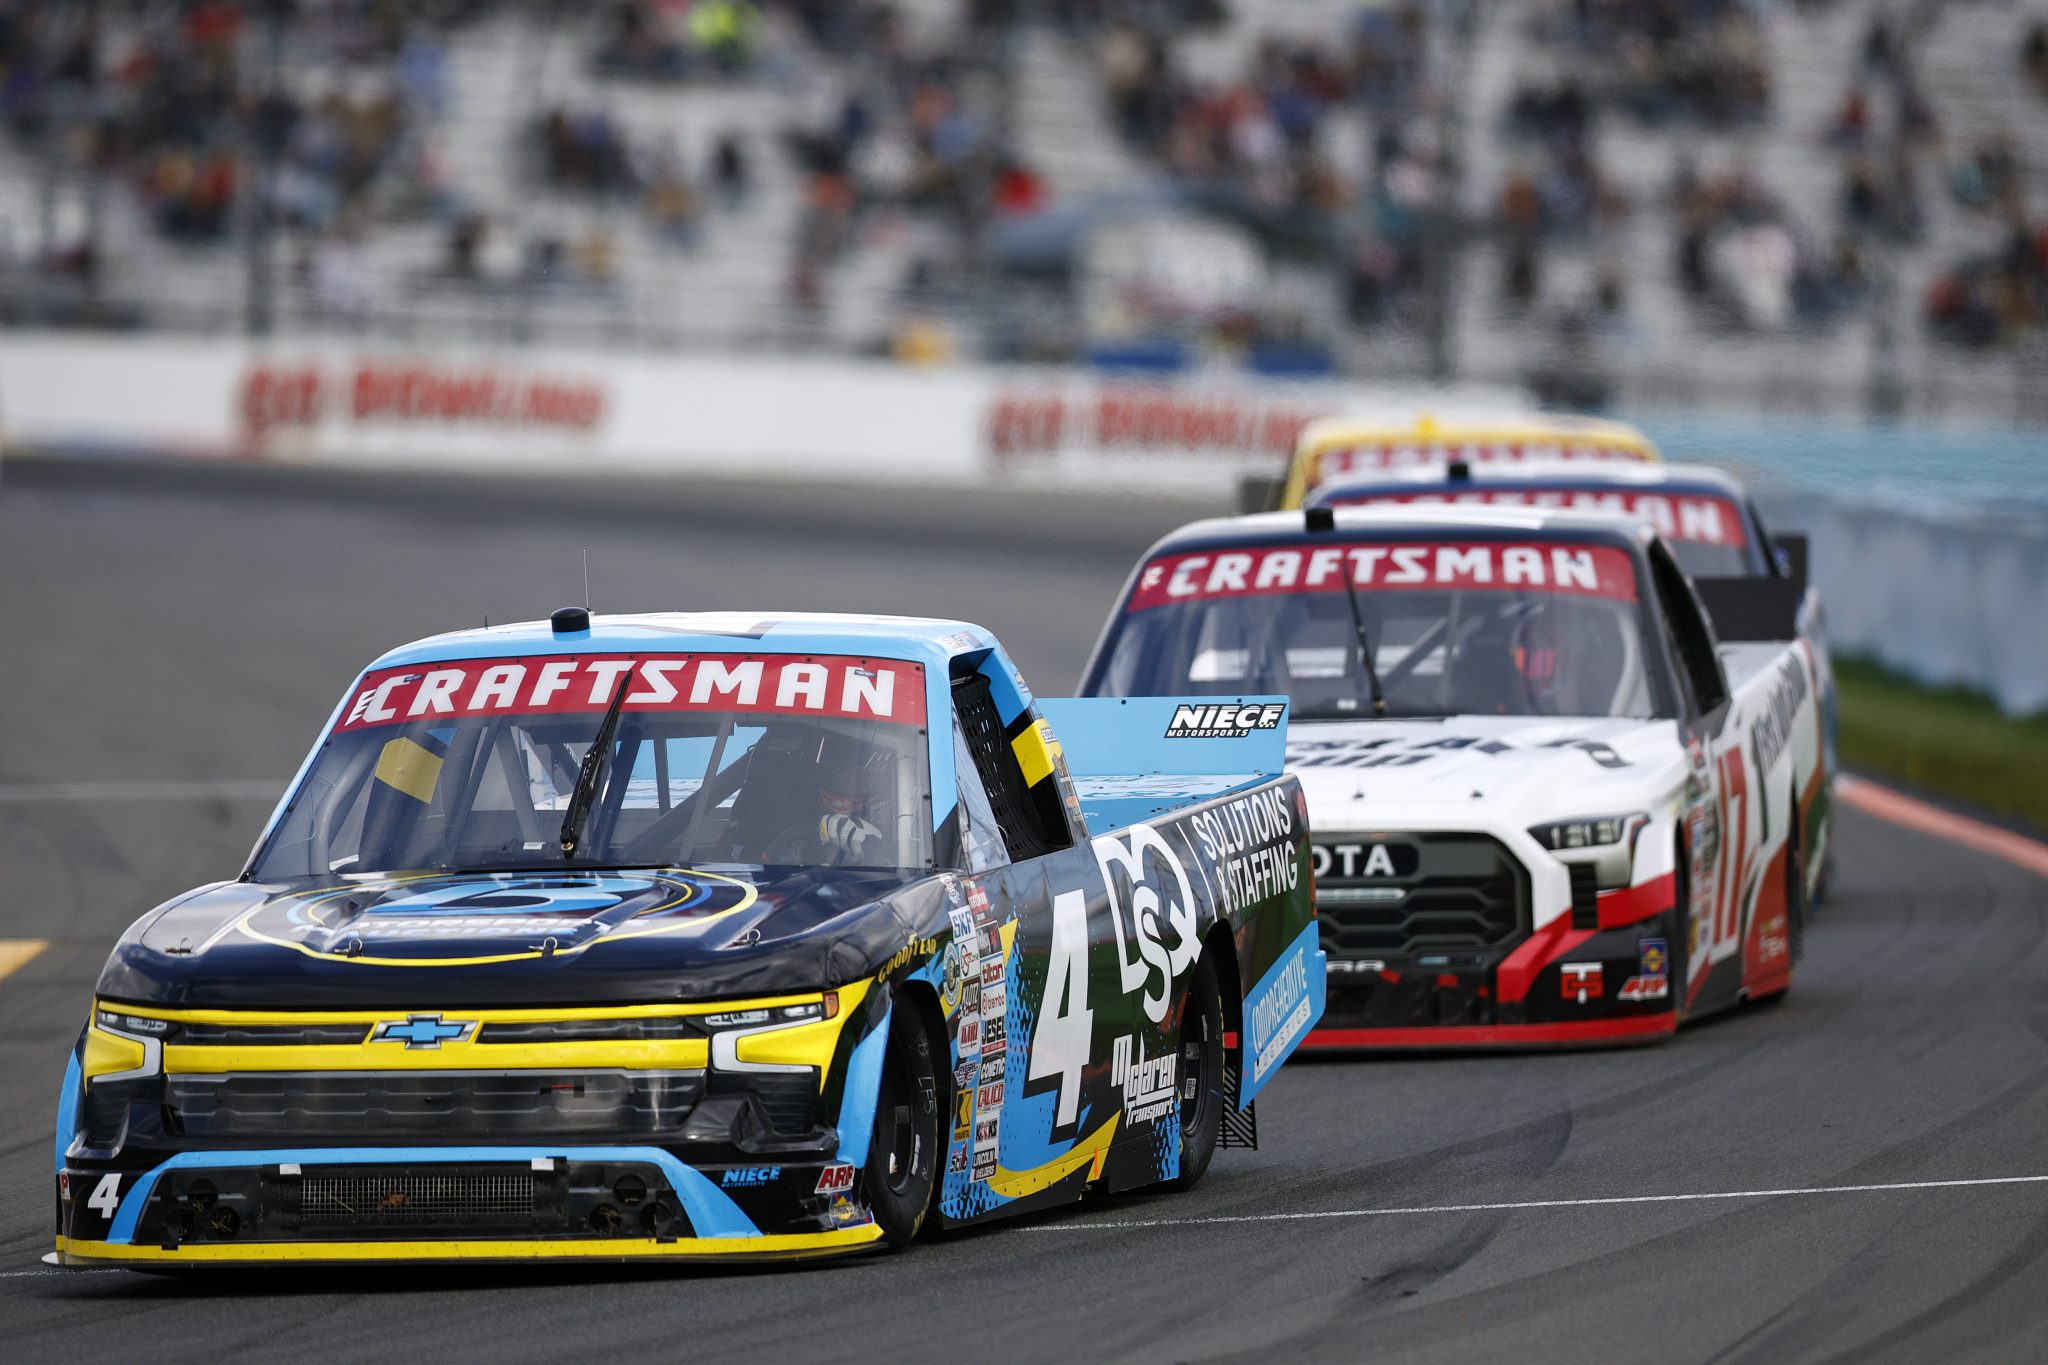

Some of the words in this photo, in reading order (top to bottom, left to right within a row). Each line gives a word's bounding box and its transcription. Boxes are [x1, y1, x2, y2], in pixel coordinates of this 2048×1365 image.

[1167, 547, 1598, 597] CRAFTSMAN
[361, 660, 895, 723] CRAFTSMAN
[1171, 704, 1285, 729] NIECE
[1167, 729, 1249, 737] MOTORSPORTS
[1190, 786, 1292, 861] SOLUTIONS
[1216, 866, 1231, 914] &
[1227, 841, 1298, 911] STAFFING
[952, 910, 972, 938] SKF
[878, 936, 937, 984] GOODYEAR
[1029, 889, 1094, 1128] 4
[981, 1016, 1007, 1044] JESEL
[977, 1082, 1004, 1109] CALICO
[1125, 1097, 1174, 1128] Transport
[973, 1150, 996, 1166] LINCOLN
[723, 1167, 782, 1182] NIECE
[818, 1165, 854, 1189] ARP
[976, 1165, 995, 1180] WELDERS
[88, 1173, 122, 1218] 4
